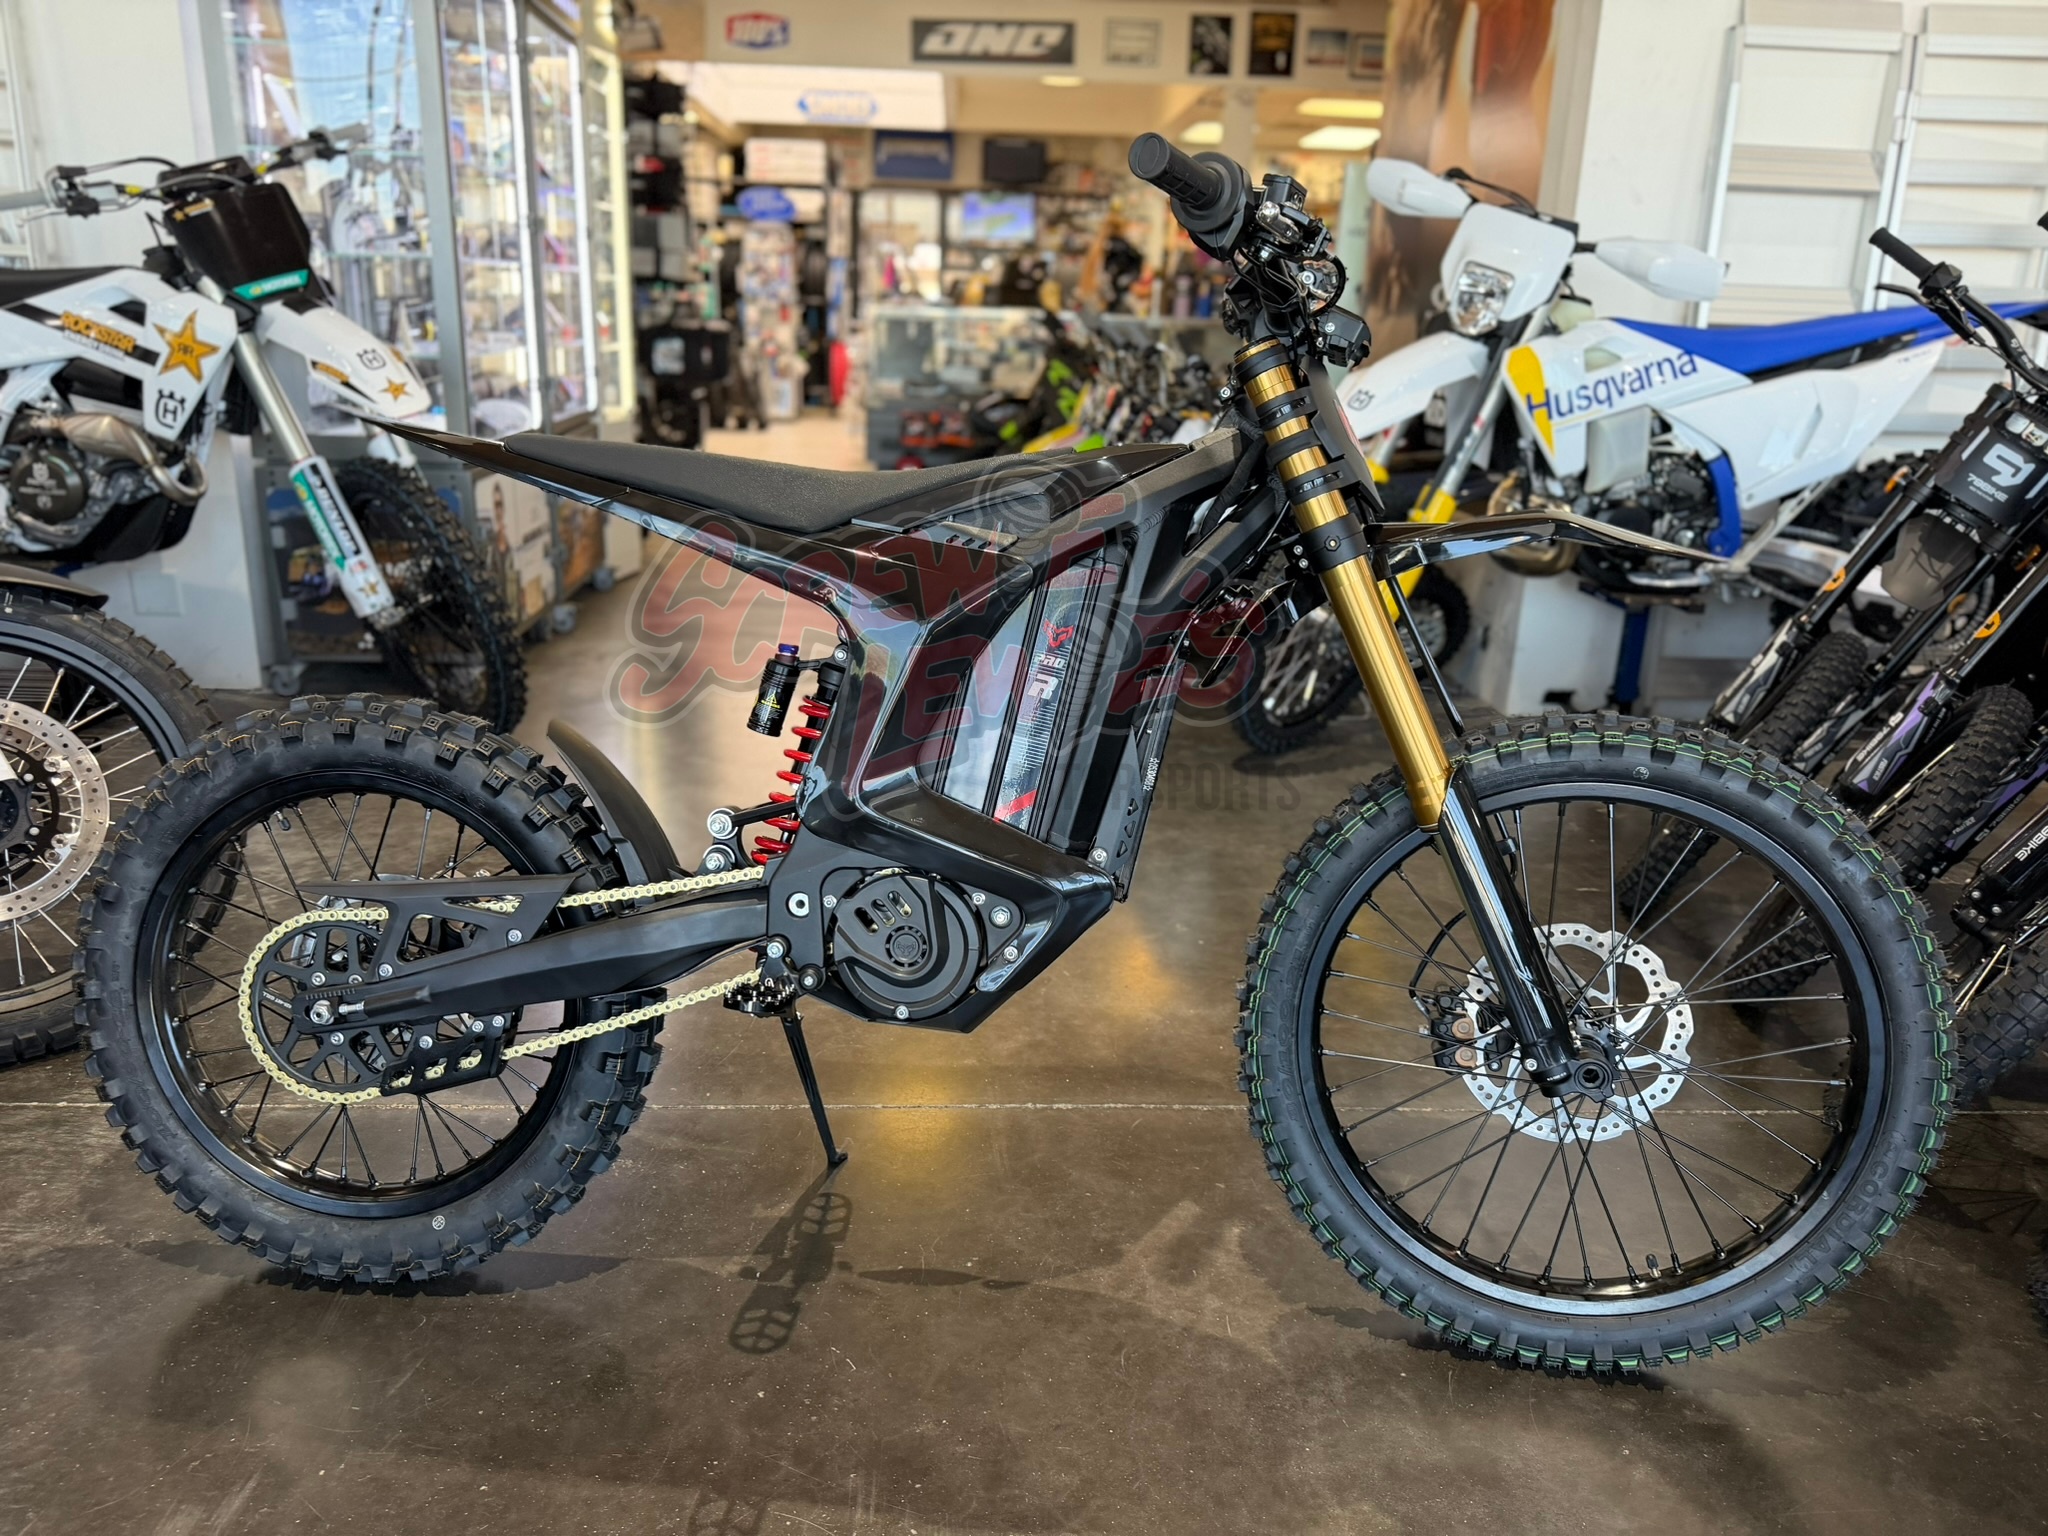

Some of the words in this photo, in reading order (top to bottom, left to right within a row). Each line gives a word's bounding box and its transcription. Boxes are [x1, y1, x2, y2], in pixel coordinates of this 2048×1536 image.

[60, 310, 136, 354] ROCKSTAR
[1526, 350, 1698, 420] Husqvarna
[1967, 472, 2009, 503] 79BIKE
[314, 485, 358, 555] DUNLOP
[1027, 675, 1059, 700] R
[1856, 724, 1891, 762] 79BIKE
[1796, 1158, 1890, 1272] CORDIAL
